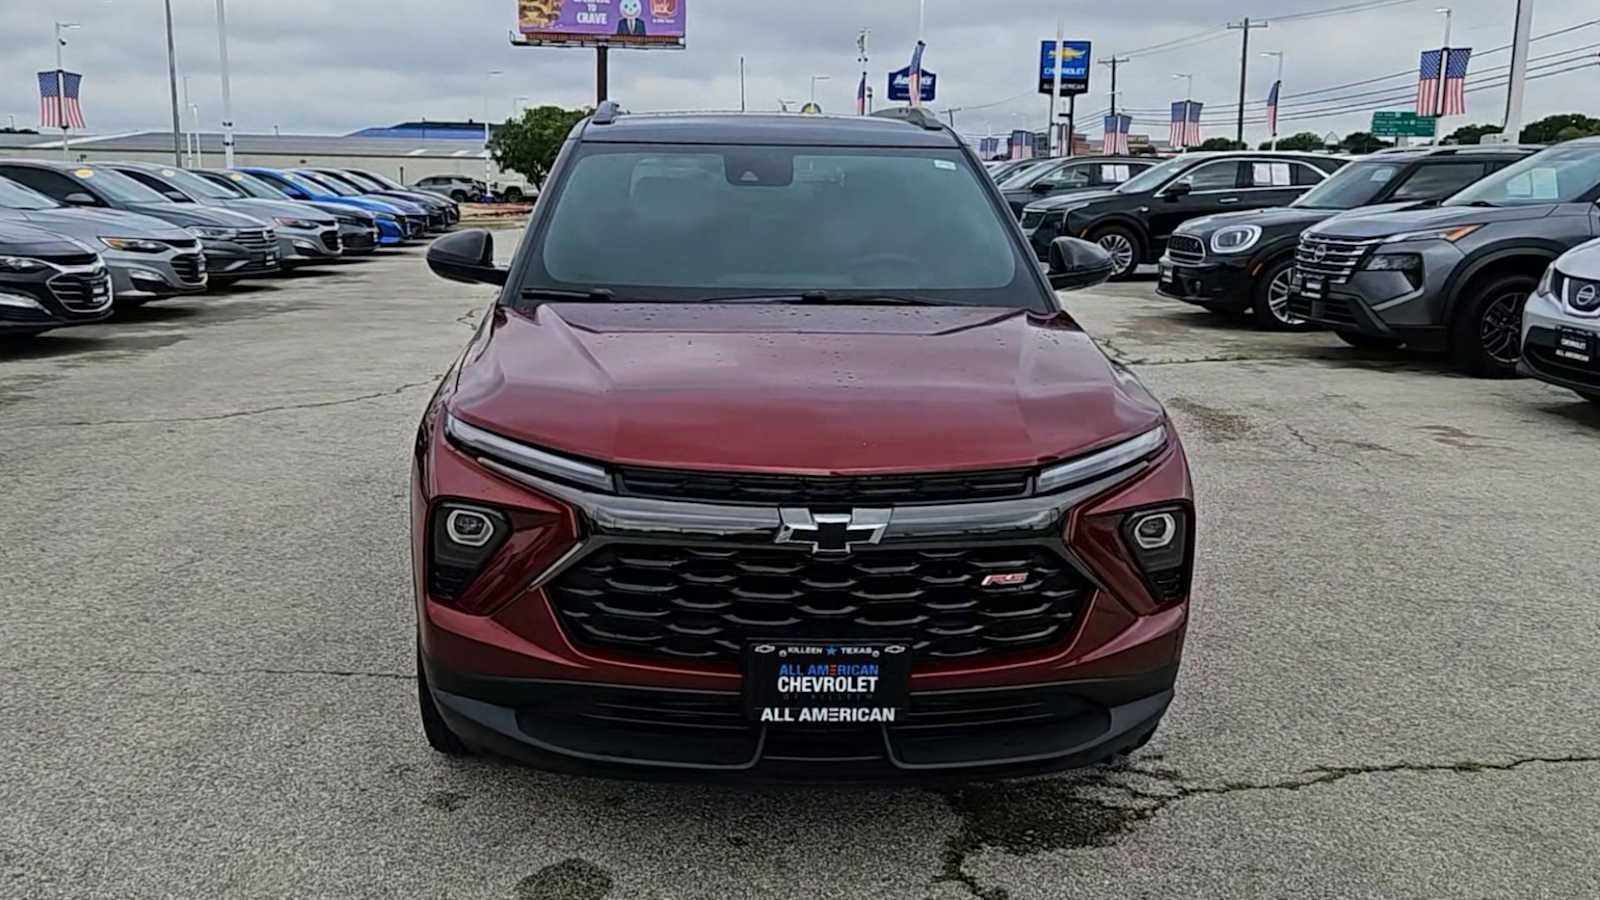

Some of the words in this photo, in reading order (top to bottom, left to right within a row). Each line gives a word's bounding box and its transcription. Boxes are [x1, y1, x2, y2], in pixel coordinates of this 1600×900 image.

[576, 12, 608, 25] CRAVE
[981, 572, 1029, 586] RS
[787, 646, 823, 655] KILLEEN
[840, 646, 873, 655] TEXAS
[779, 664, 804, 676] ALL
[807, 664, 879, 676] AMERICAN
[777, 676, 879, 693] CHEVROLET
[760, 707, 795, 722] ALL
[798, 707, 896, 722] AMERICAN
